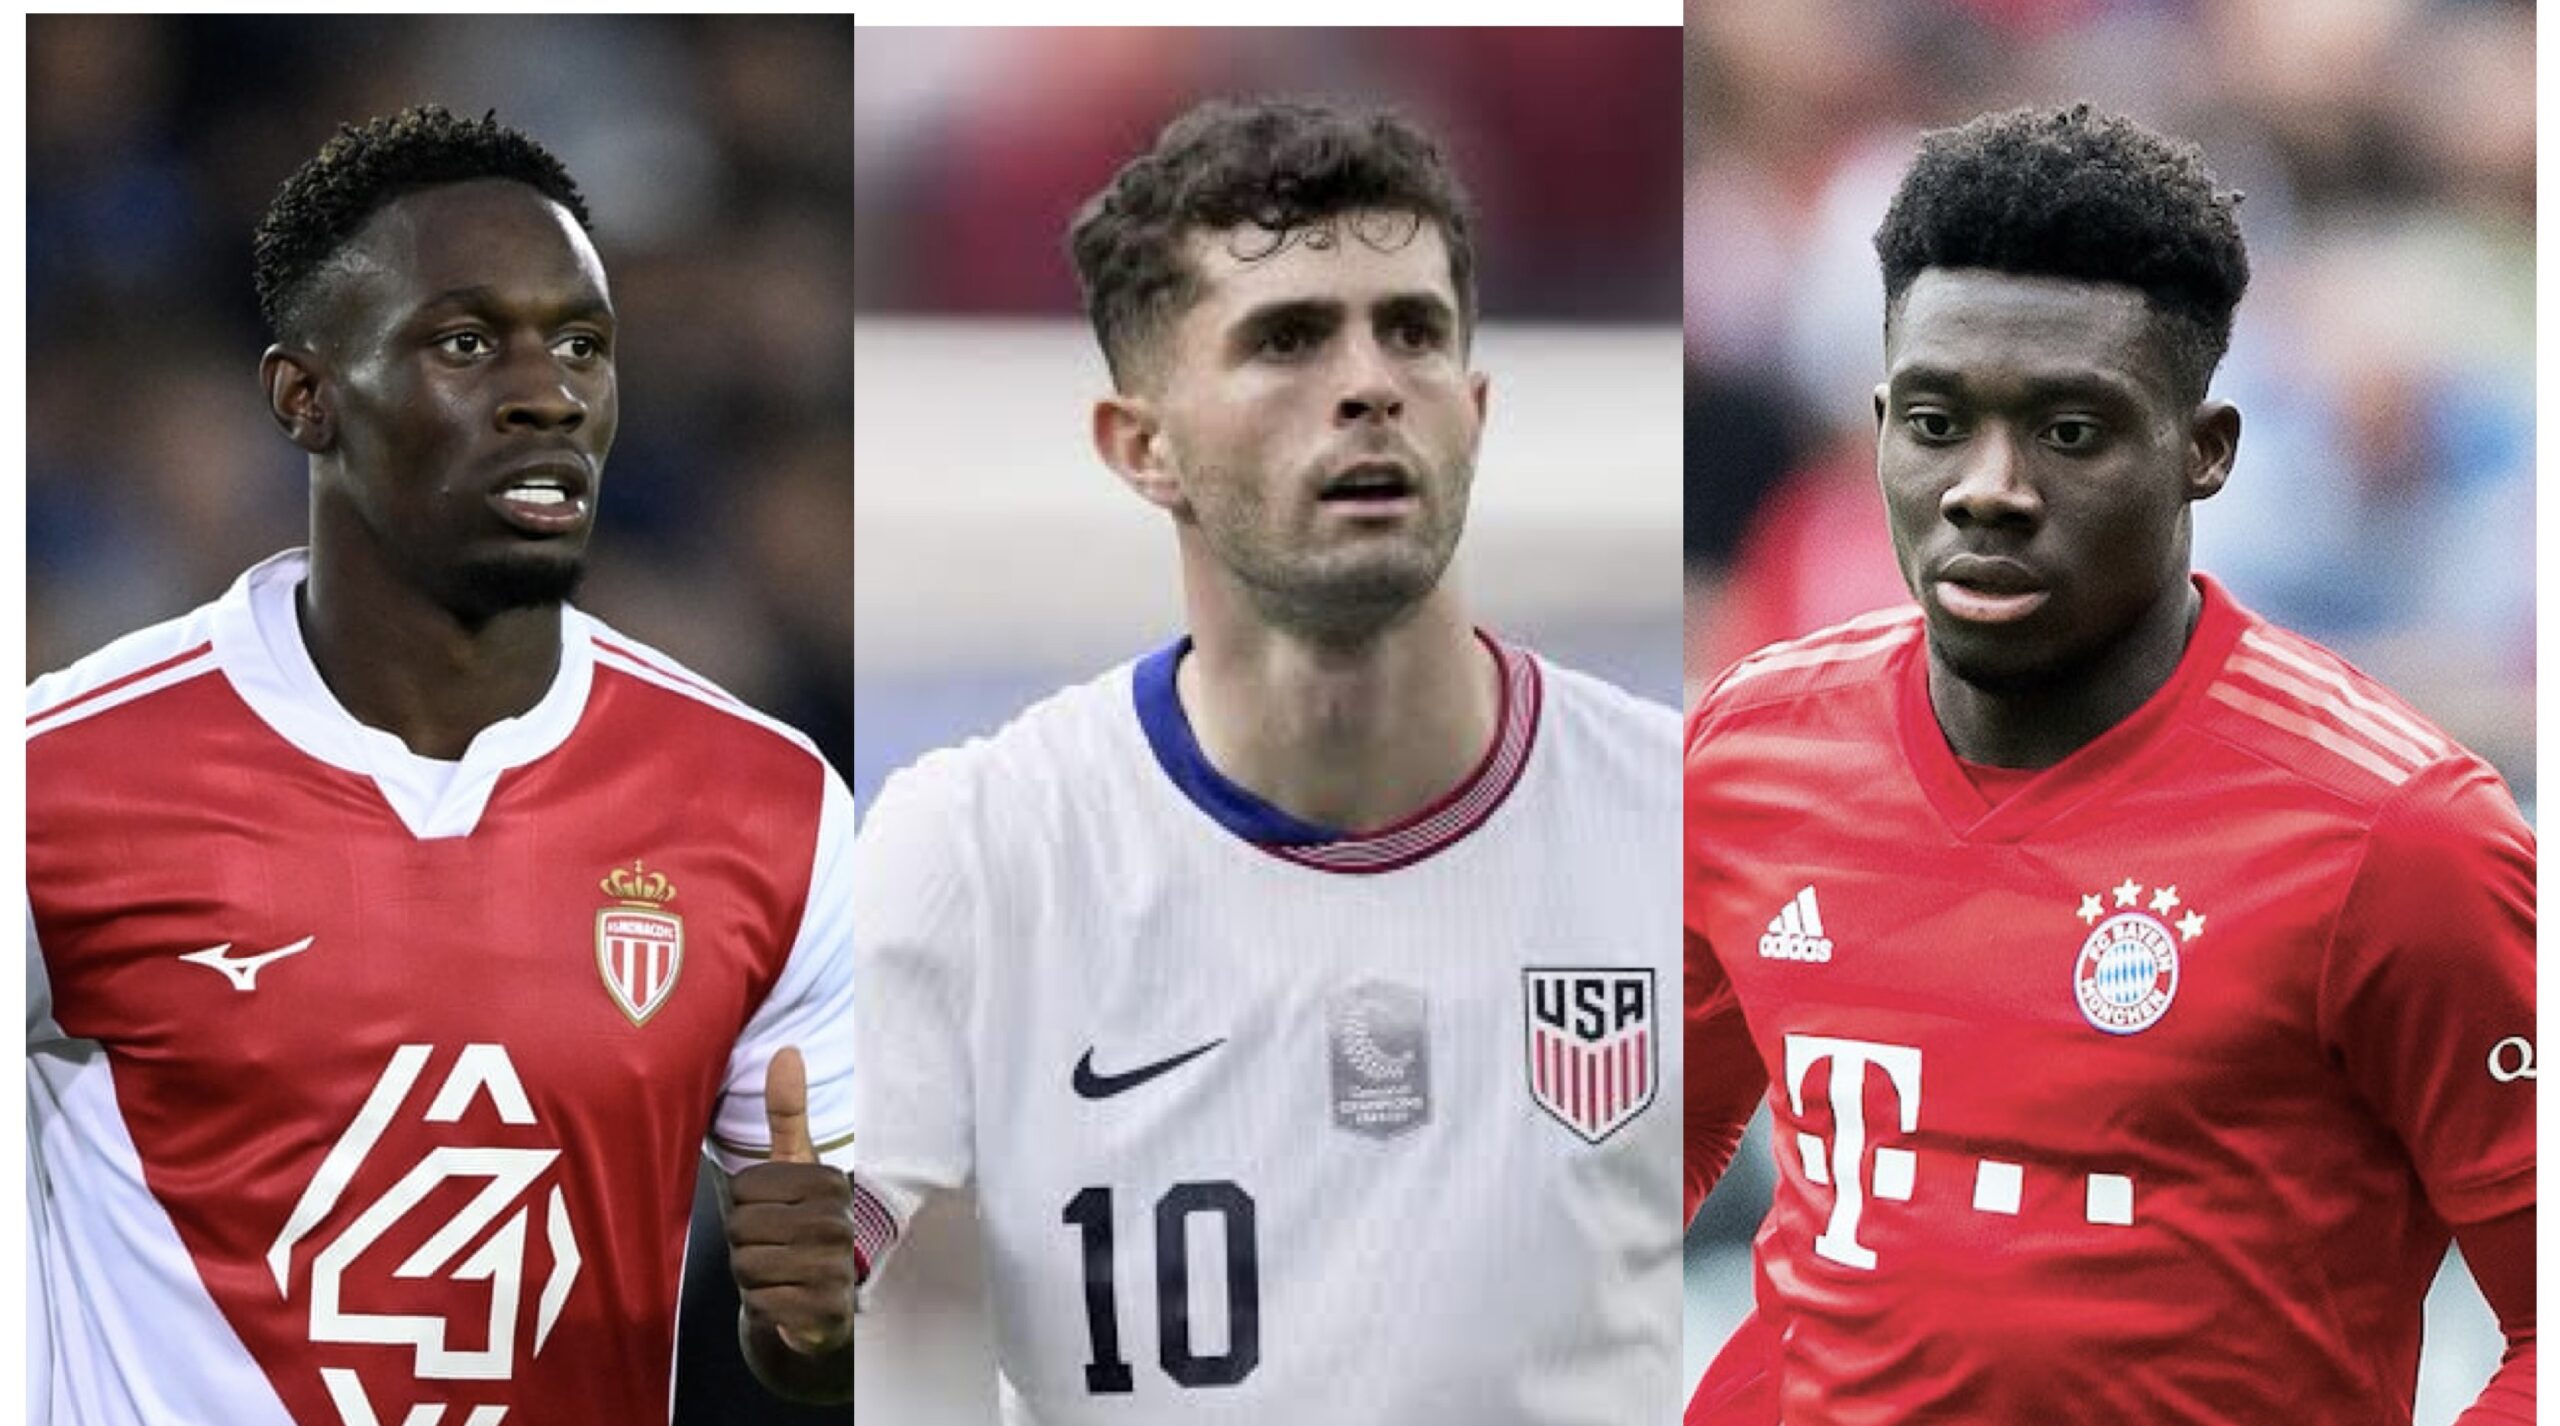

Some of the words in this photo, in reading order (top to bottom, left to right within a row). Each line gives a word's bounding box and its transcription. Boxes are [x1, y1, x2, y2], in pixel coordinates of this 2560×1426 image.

[1759, 933, 1833, 963] adidas
[2089, 926, 2115, 962] FC
[2113, 922, 2173, 973] BAYERN
[1535, 979, 1644, 1042] USA
[1062, 1180, 1259, 1393] 10
